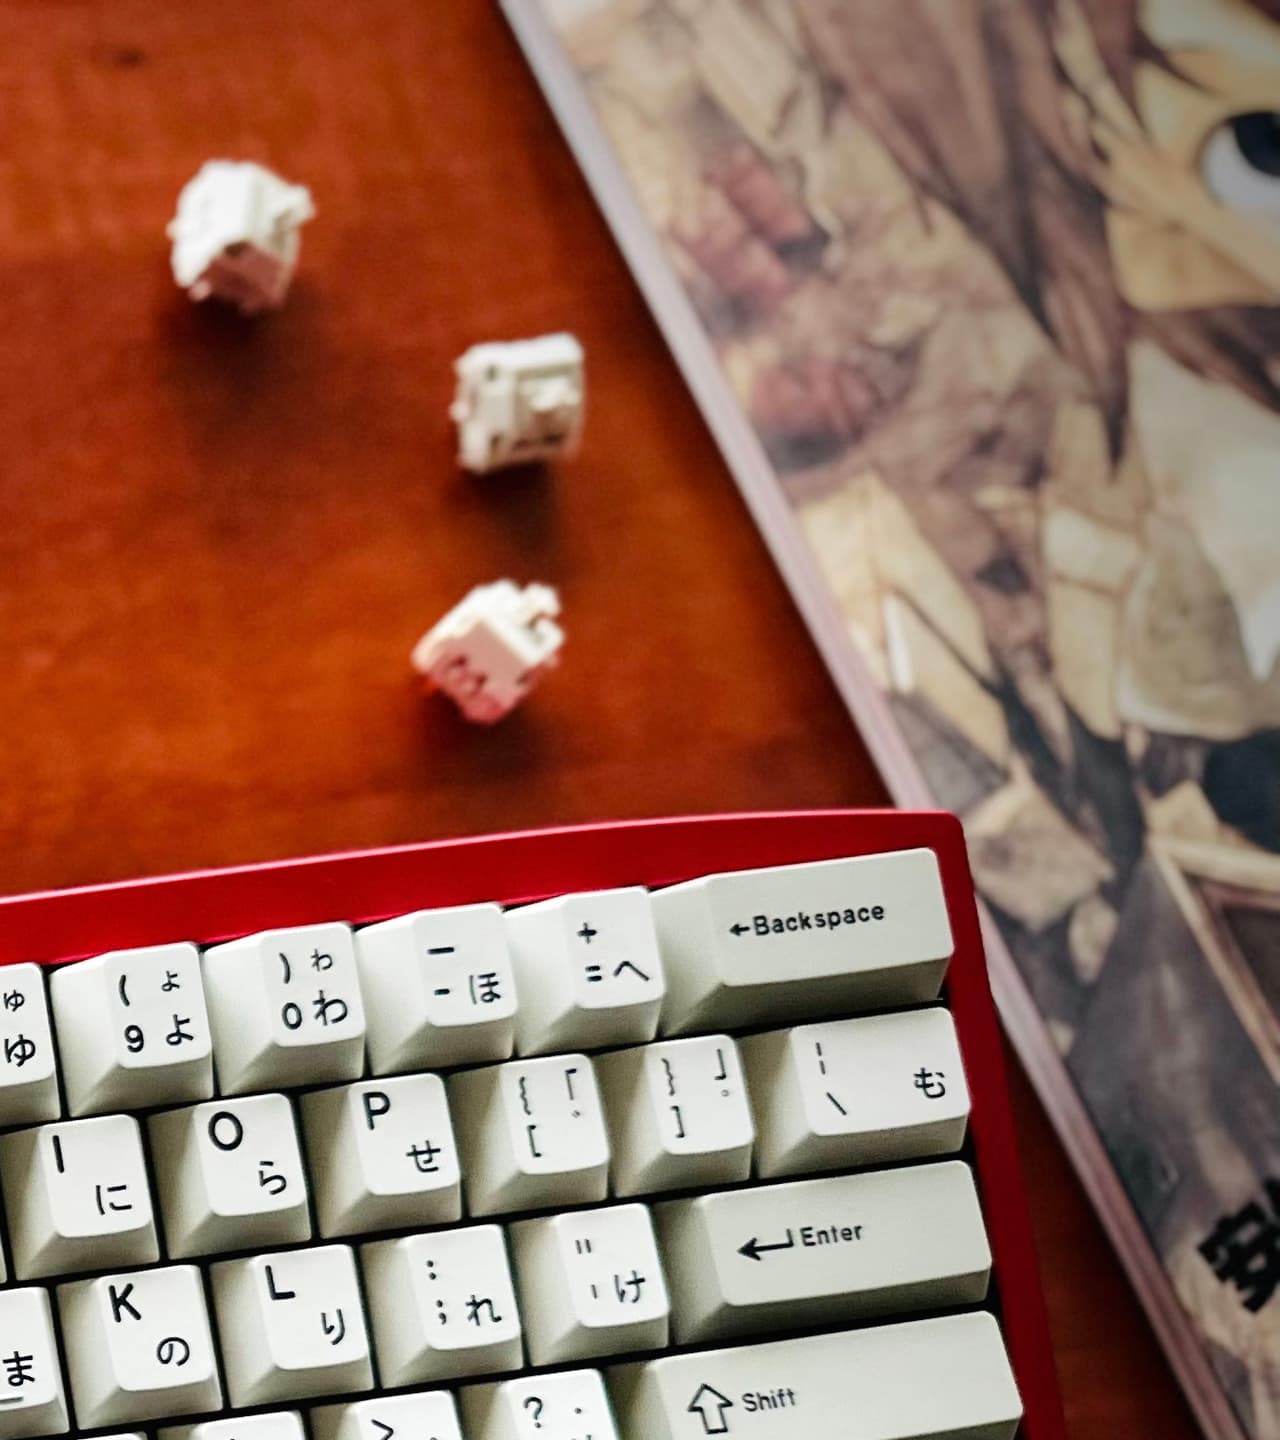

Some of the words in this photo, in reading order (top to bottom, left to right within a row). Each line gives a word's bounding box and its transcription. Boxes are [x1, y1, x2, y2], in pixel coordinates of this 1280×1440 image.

[577, 922, 598, 944] +
[752, 905, 885, 936] Backspace
[469, 972, 502, 1005] ほ
[281, 1002, 303, 1031] 0
[312, 989, 349, 1026] わ
[4, 1033, 36, 1068] ゆ
[124, 1024, 145, 1054] 9
[165, 1013, 195, 1046] よ
[913, 1067, 946, 1100] む
[362, 1091, 391, 1131] P
[670, 1104, 686, 1139] ]
[207, 1110, 244, 1152] O
[526, 1124, 543, 1159] [
[405, 1139, 441, 1173] せ
[258, 1160, 287, 1196] ら
[95, 1184, 133, 1216] に
[799, 1225, 863, 1247] Enter
[264, 1264, 296, 1301] L
[613, 1270, 647, 1304] け
[108, 1282, 142, 1323] K
[465, 1294, 503, 1327] れ
[320, 1308, 346, 1346] り
[2, 1350, 36, 1387] ま
[156, 1336, 191, 1367] の
[523, 1396, 544, 1429] ?
[741, 1388, 796, 1413] Shift
